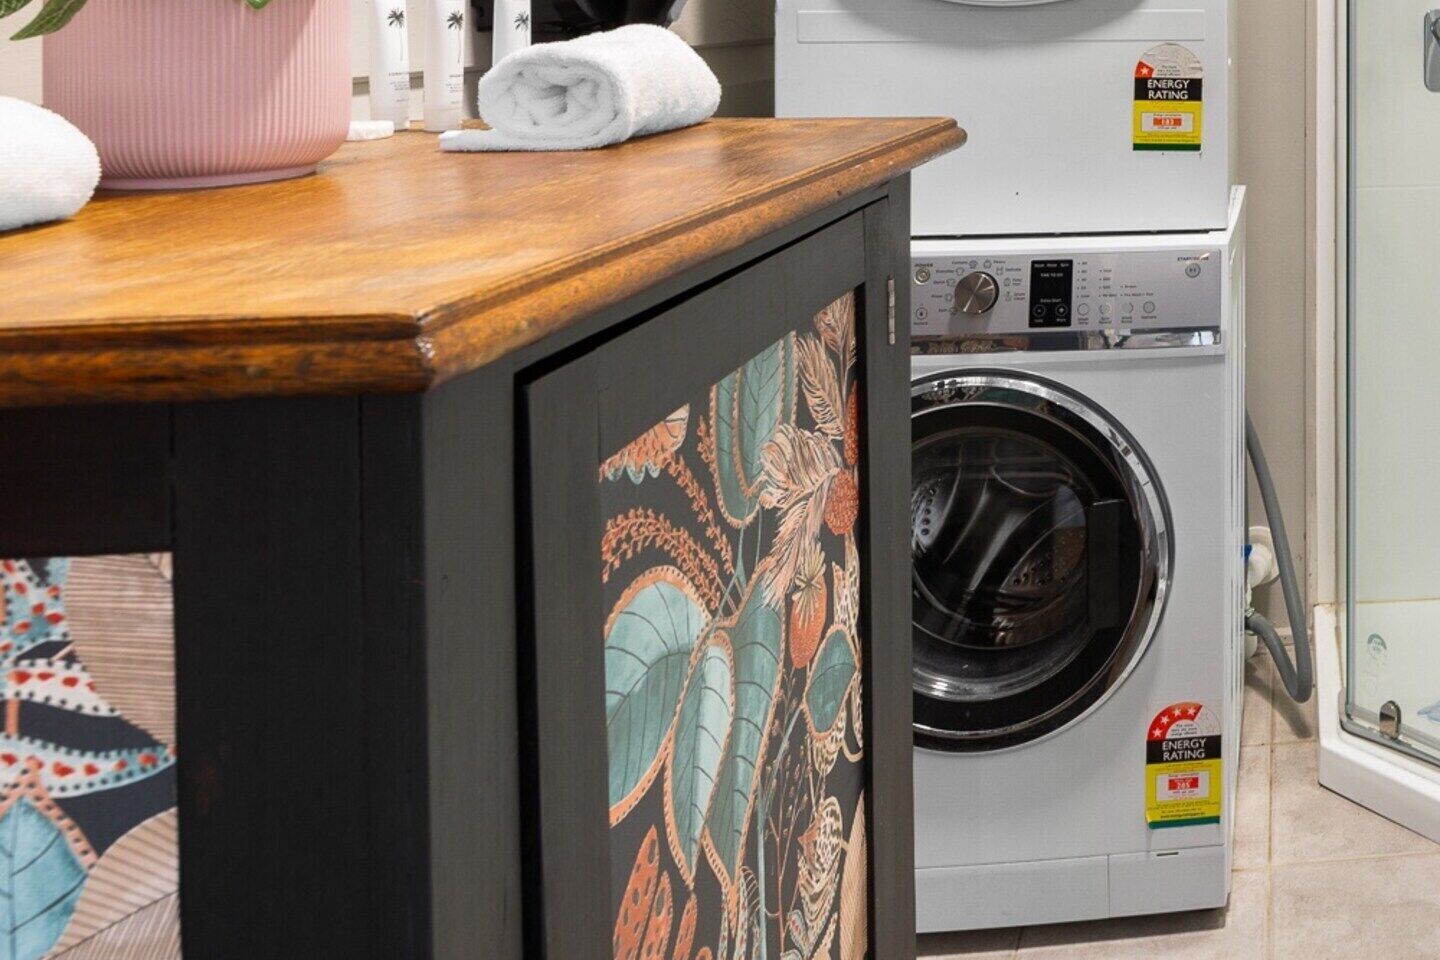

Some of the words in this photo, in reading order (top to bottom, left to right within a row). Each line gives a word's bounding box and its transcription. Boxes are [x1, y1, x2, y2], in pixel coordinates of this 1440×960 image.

[1147, 79, 1191, 89] ENERGY
[1148, 90, 1189, 100] RATING
[1162, 738, 1206, 750] ENERGY
[1163, 749, 1205, 760] RATING
